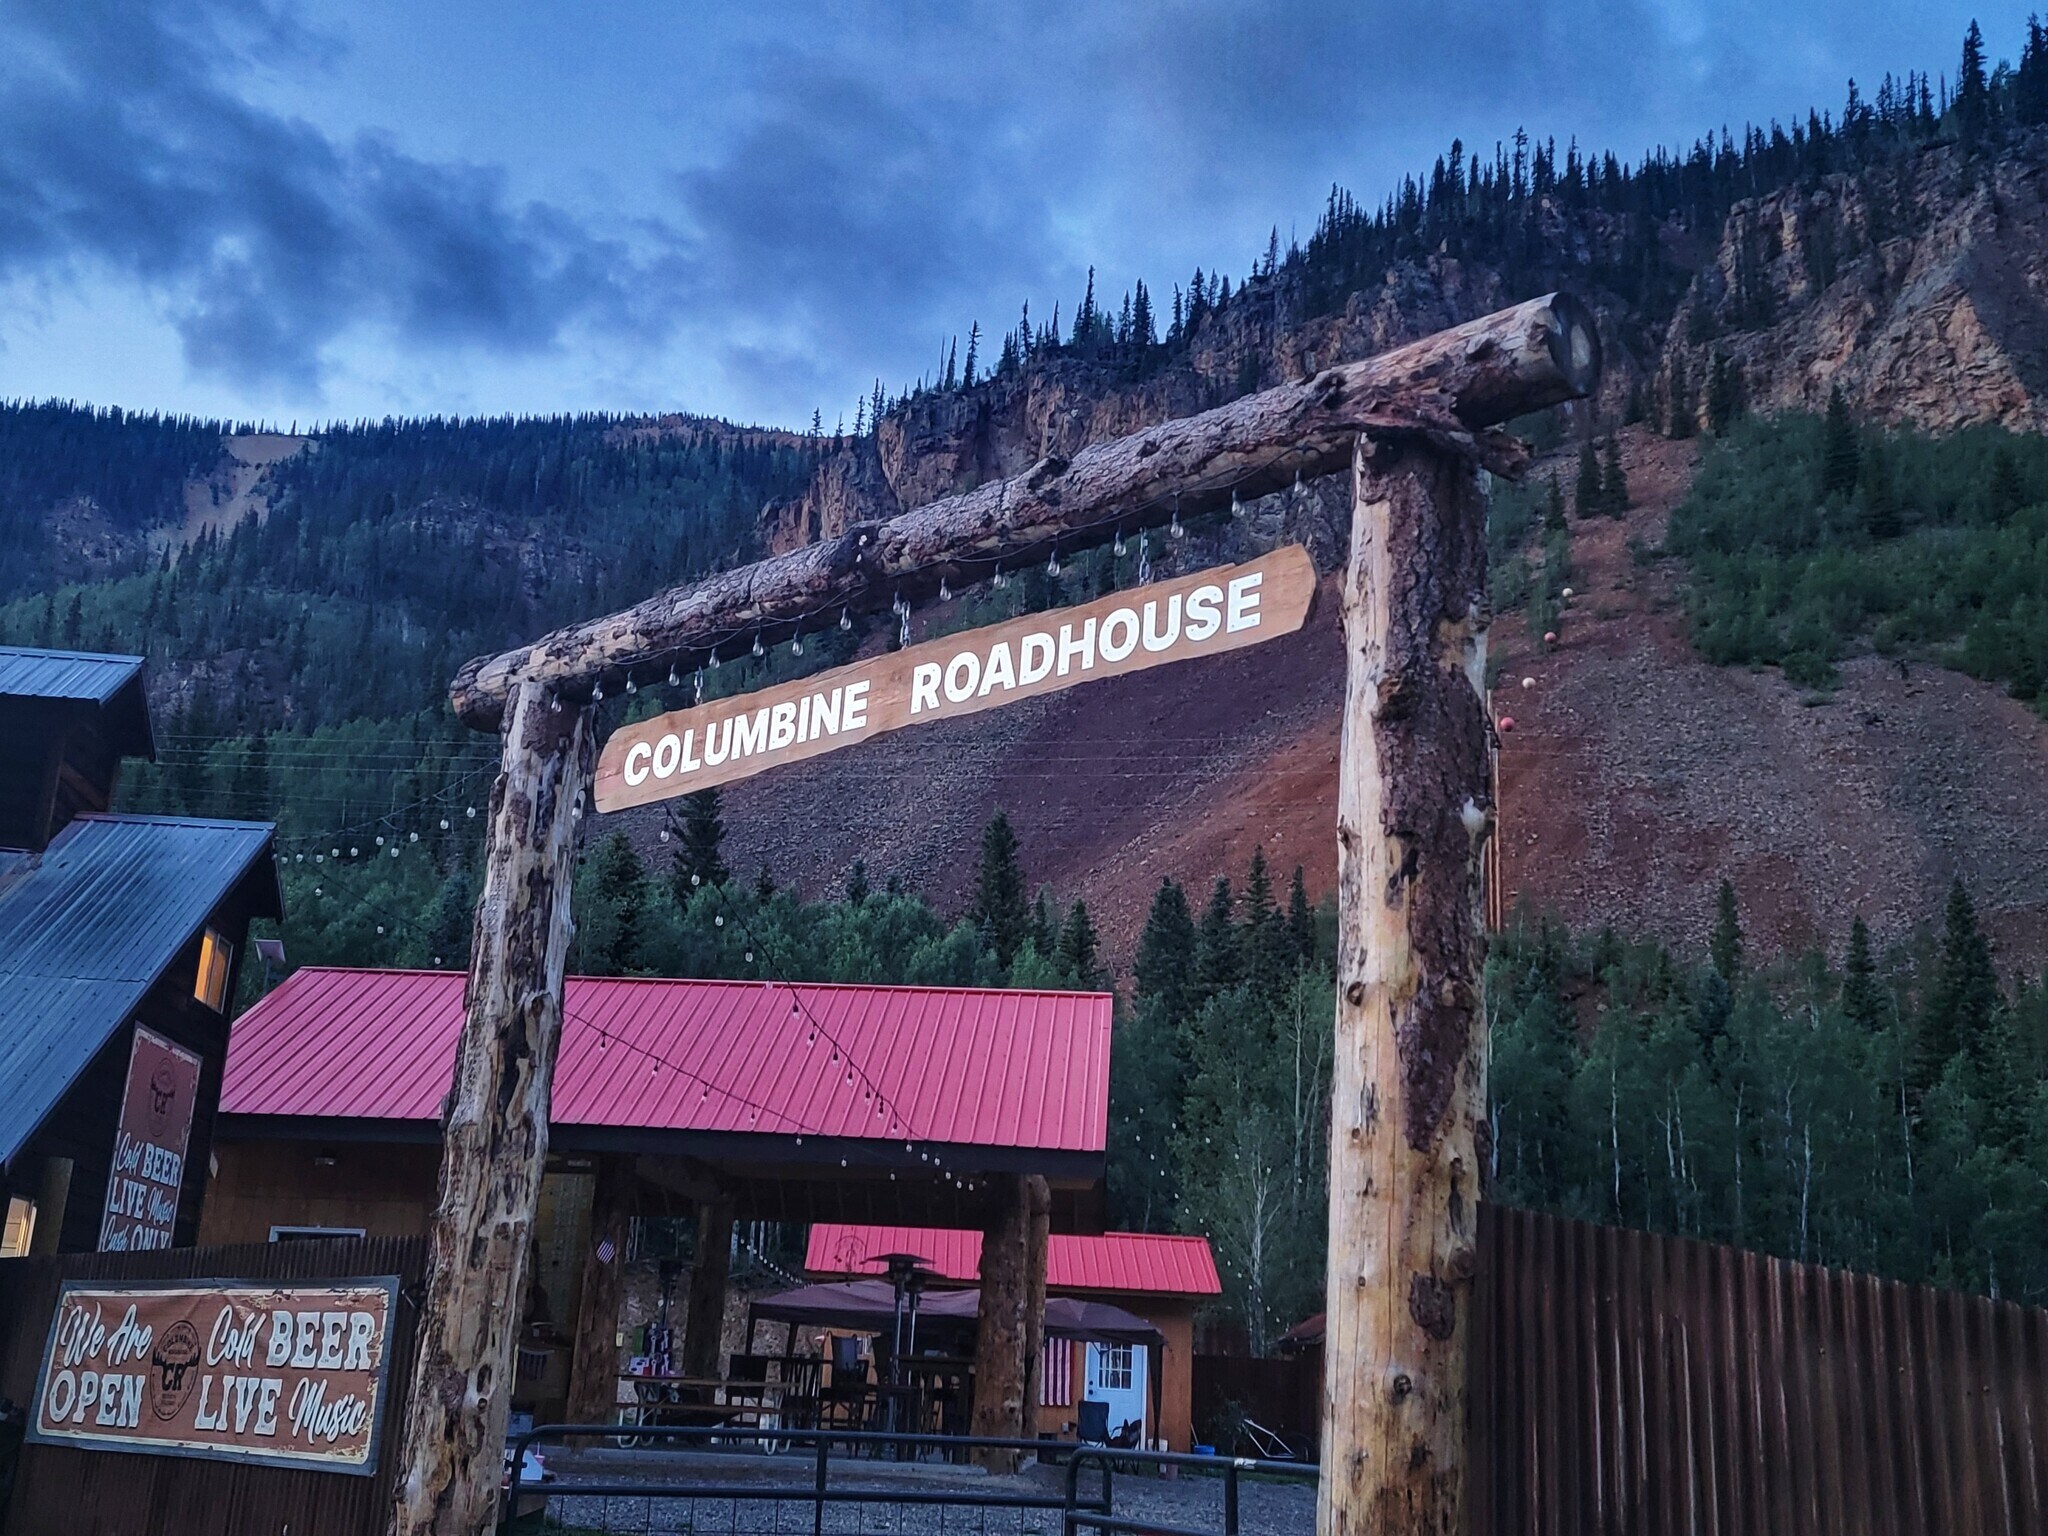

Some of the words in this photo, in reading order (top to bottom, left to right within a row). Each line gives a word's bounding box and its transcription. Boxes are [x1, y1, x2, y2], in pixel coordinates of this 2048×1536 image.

[623, 679, 871, 787] COLUMBINE
[909, 571, 1264, 716] ROADHOUSE
[116, 1131, 144, 1175] Cold
[141, 1143, 182, 1187] BEER
[109, 1176, 147, 1220] LIVE
[147, 1186, 174, 1226] Music
[60, 1302, 105, 1367] We
[107, 1304, 153, 1367] Are
[206, 1304, 266, 1369] Cold
[266, 1311, 376, 1370] BEER
[49, 1370, 146, 1428] OPEN
[194, 1375, 282, 1435] LIVE
[289, 1378, 366, 1444] Music
